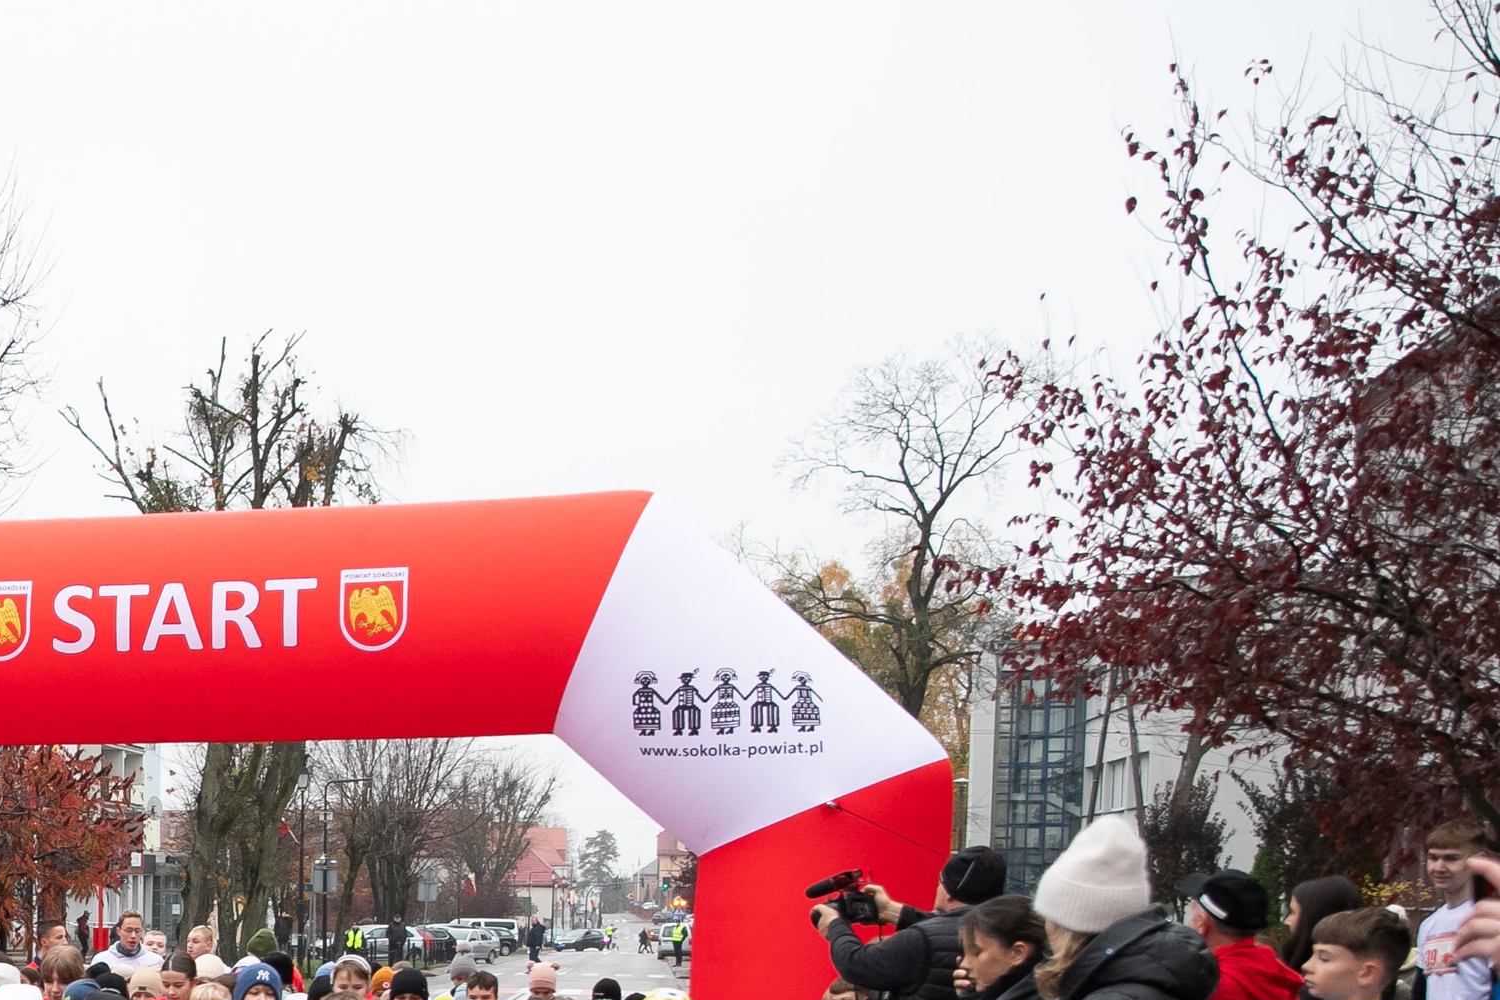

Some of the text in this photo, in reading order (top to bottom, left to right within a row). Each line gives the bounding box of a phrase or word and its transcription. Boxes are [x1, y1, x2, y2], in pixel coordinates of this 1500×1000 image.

[345, 571, 405, 580] POWIAT SOKÓLSKI
[51, 577, 318, 654] START
[639, 740, 824, 759] www.sokolka-powiat.pl
